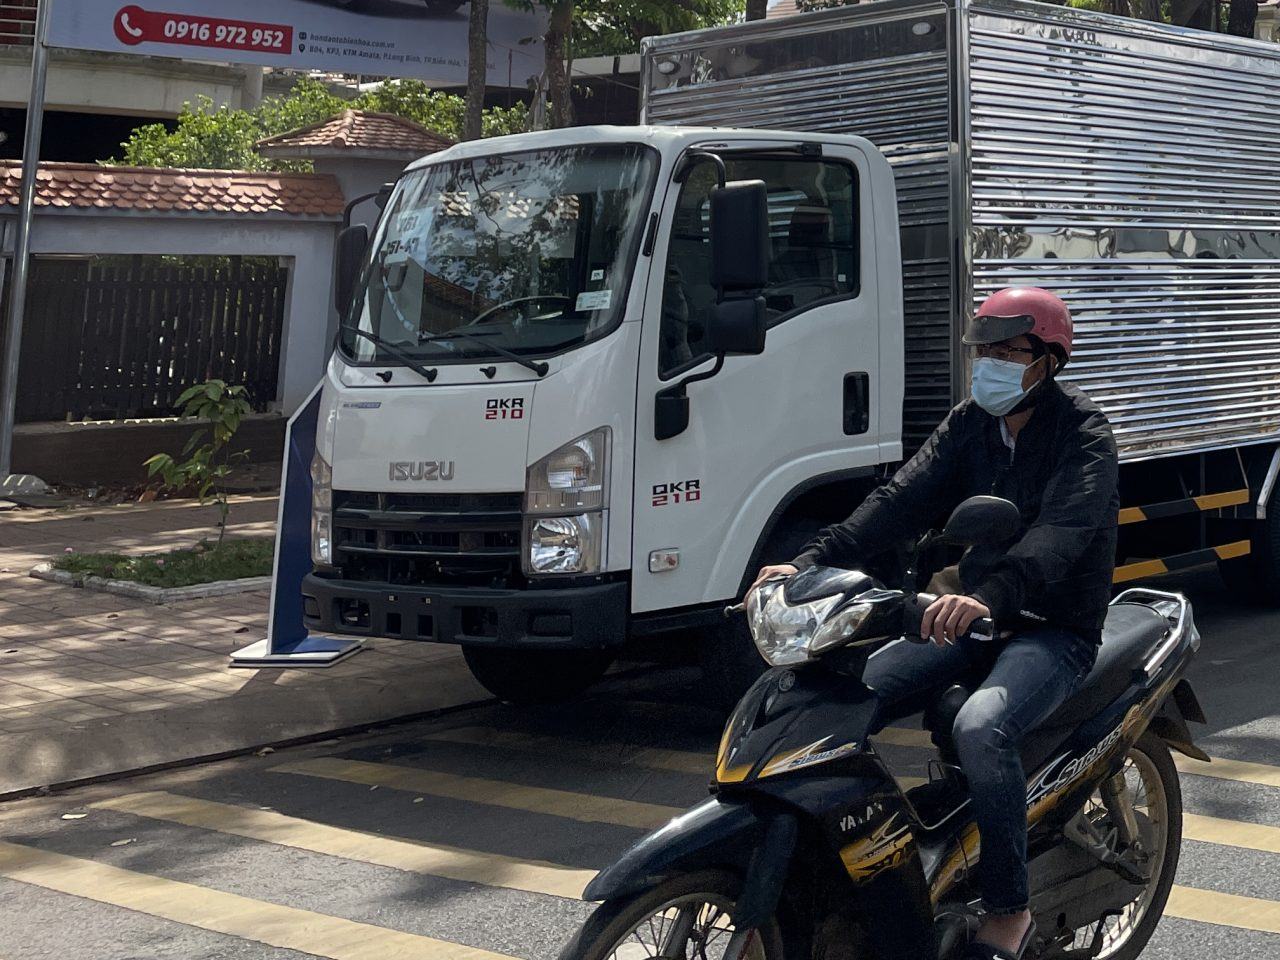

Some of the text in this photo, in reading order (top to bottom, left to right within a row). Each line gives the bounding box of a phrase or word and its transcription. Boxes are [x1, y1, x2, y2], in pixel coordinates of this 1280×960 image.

[164, 20, 284, 48] 0916 972 952
[486, 398, 524, 409] QKR
[485, 409, 523, 420] 210
[389, 461, 455, 481] ISUZU
[652, 479, 700, 495] QKR
[652, 490, 700, 507] 210
